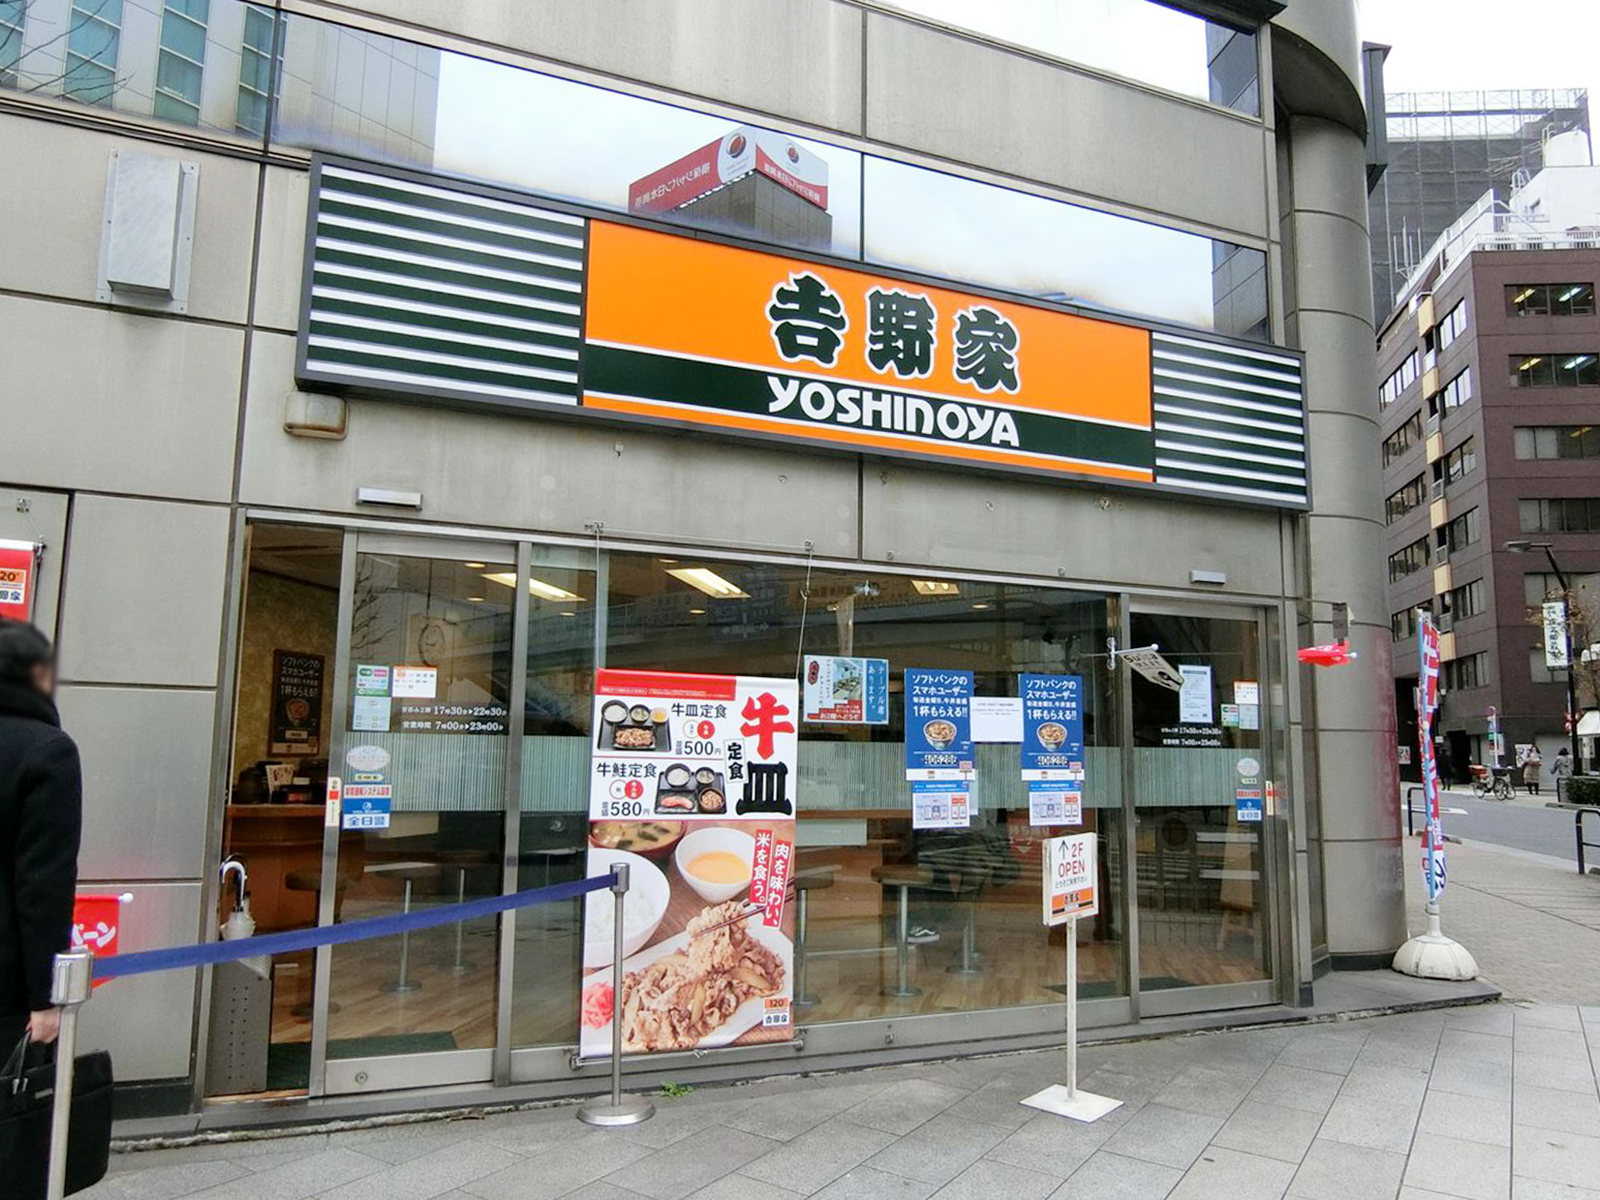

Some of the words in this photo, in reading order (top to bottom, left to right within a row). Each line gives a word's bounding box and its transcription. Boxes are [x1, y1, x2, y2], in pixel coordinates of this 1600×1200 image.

[765, 271, 1021, 395] 吉野家
[912, 674, 968, 686] ソフトバンクの
[1026, 679, 1077, 691] ソフトバンクの
[912, 685, 968, 697] スマホユーザー
[1026, 689, 1077, 701] スマホユーザー
[671, 702, 728, 719] 牛皿定食
[726, 741, 745, 783] 定食
[735, 691, 796, 816] 牛皿
[596, 761, 658, 779] 牛鮭定食
[1071, 842, 1084, 858] 2F
[1058, 860, 1086, 878] OPEN
